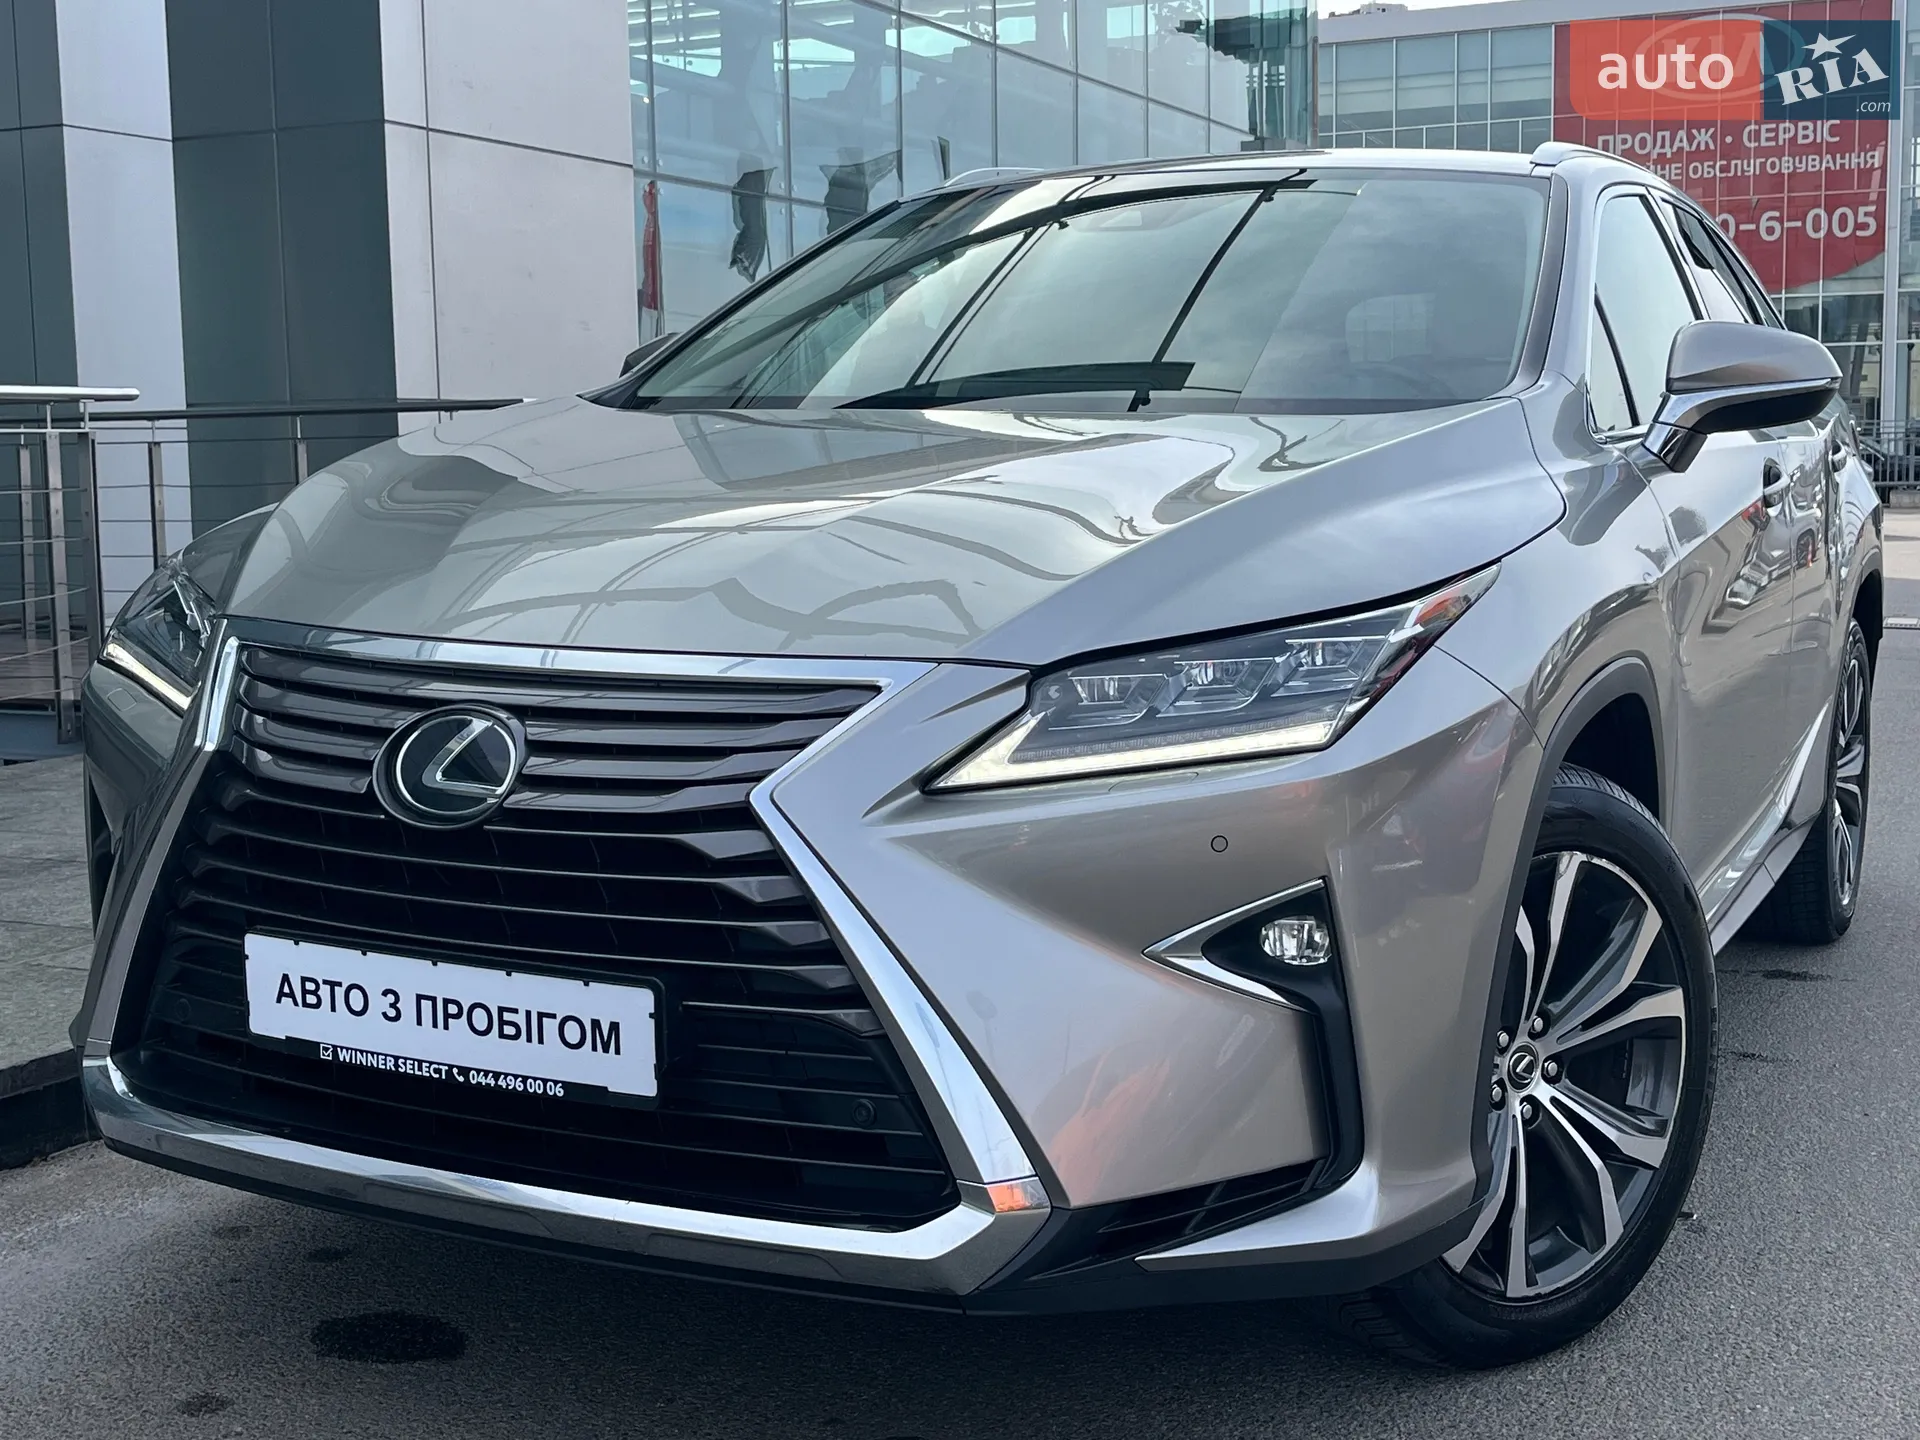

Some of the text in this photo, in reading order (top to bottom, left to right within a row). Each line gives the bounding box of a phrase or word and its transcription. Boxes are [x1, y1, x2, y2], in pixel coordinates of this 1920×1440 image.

[1597, 119, 1841, 160] ПРОДАЖ СЕРВІС
[1688, 151, 1880, 179] ОБСЛУГОВУВАННЯ
[276, 973, 369, 1018] АВТО
[415, 993, 621, 1056] ПРОБІГОМ
[337, 1047, 565, 1097] WINNER SELECT 044 496 00 06
